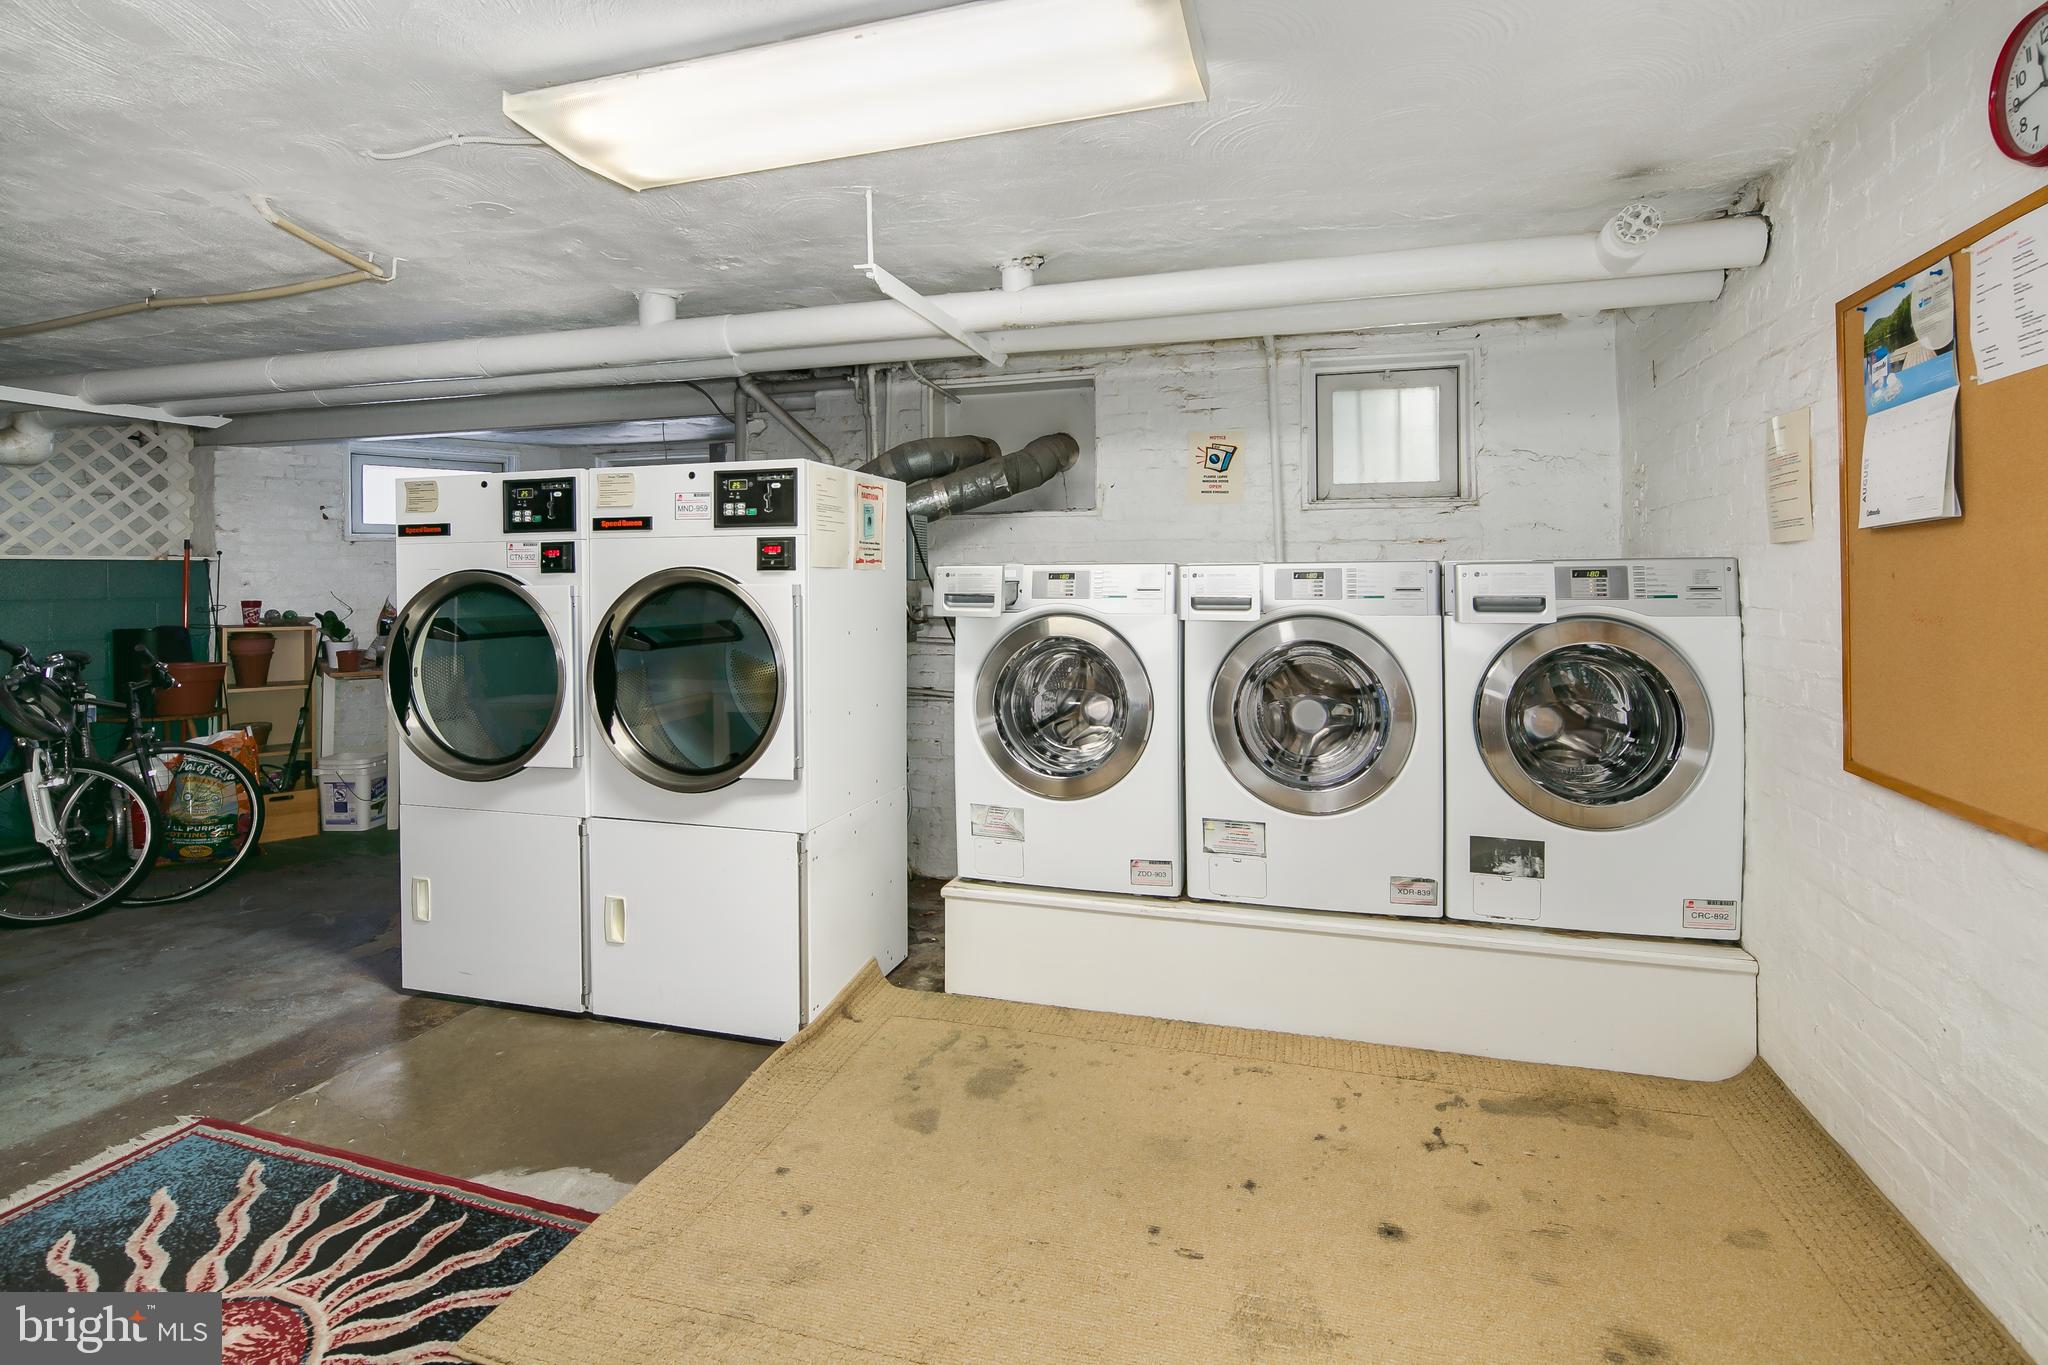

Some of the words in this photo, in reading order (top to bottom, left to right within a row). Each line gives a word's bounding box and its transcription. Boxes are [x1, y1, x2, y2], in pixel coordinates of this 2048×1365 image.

[2025, 47, 2032, 63] 11
[2015, 70, 2027, 88] 10
[2012, 97, 2021, 113] 9
[2019, 116, 2028, 134] 8
[2031, 124, 2041, 142] 7
[677, 504, 708, 512] MND-959
[601, 520, 621, 528] Speed
[186, 824, 235, 832] PURPOSE
[1397, 888, 1431, 897] XDR-839
[1691, 911, 1729, 920] CRC-892
